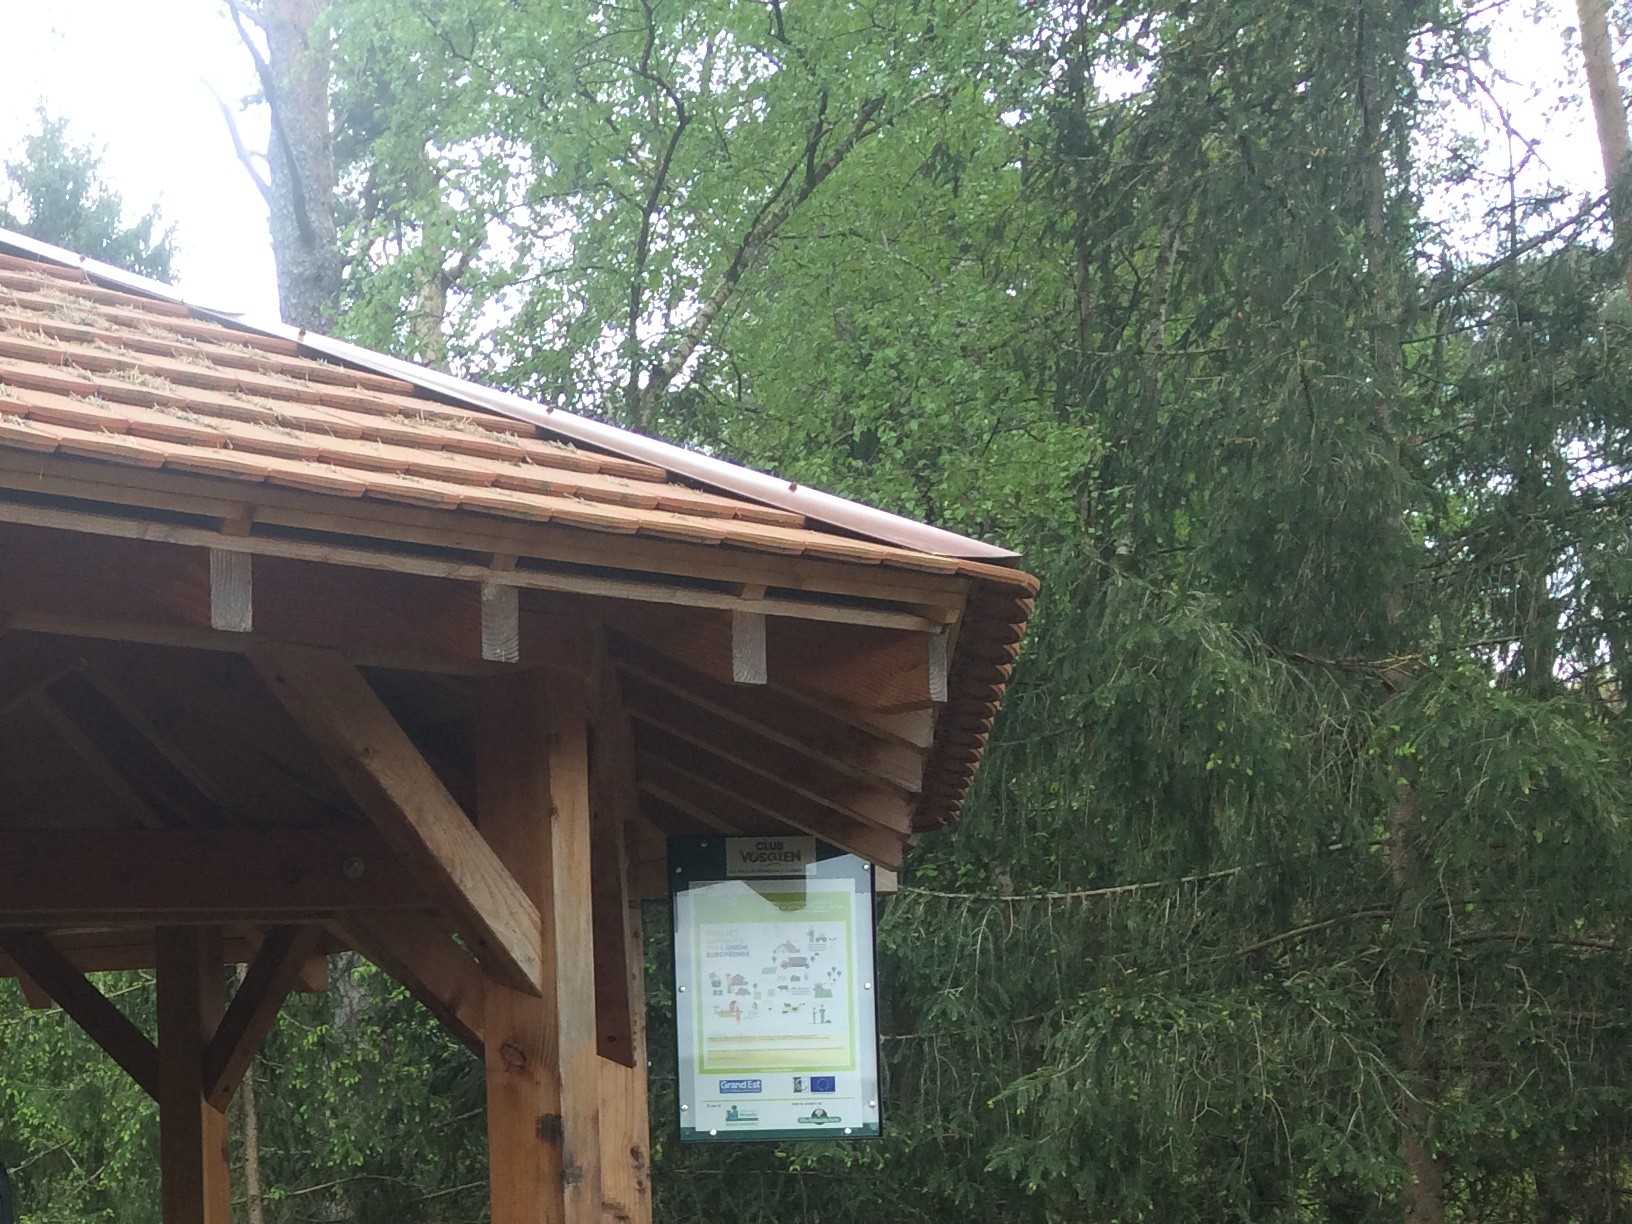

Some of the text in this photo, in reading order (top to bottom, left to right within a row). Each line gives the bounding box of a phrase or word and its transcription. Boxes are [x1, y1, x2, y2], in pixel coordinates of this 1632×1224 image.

[756, 841, 784, 850] CLUB
[739, 849, 801, 863] VOSGIEN
[720, 1080, 761, 1089] Grand Est
